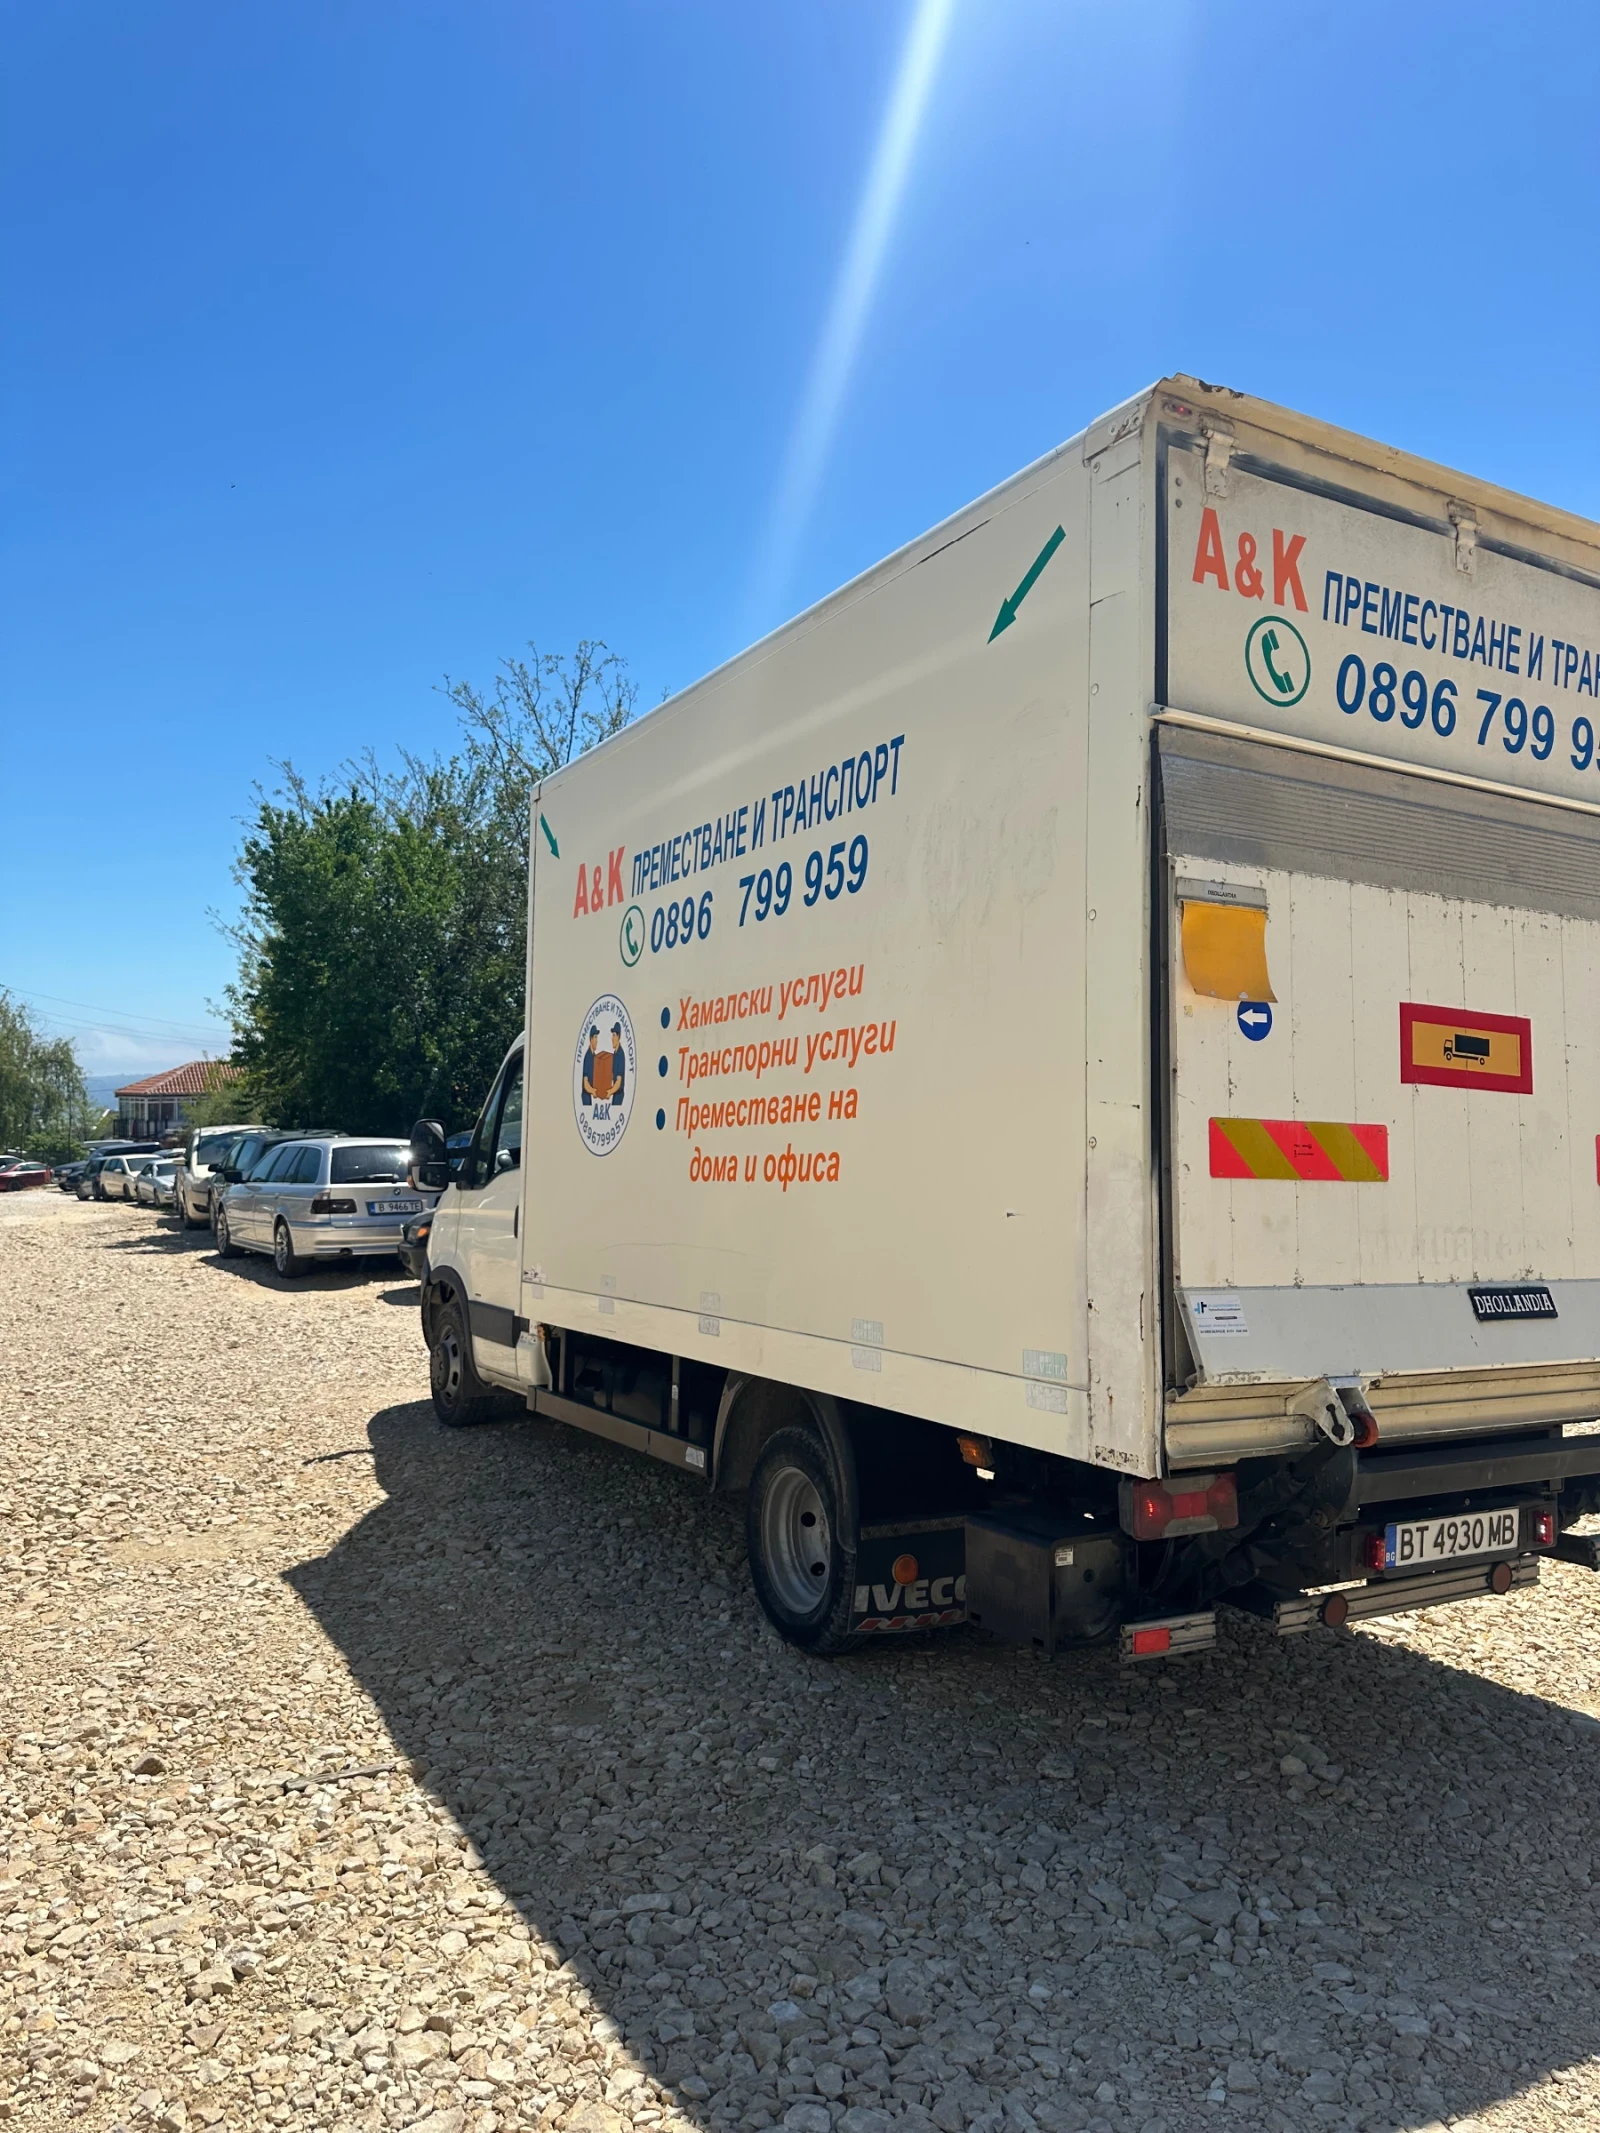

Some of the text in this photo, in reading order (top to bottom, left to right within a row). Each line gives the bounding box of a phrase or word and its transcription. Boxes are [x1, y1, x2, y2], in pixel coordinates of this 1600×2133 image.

[1323, 570, 1522, 674] ПРЕМЕСТВАНЕ
[1527, 632, 1544, 681] И
[1336, 654, 1600, 773] 0896 799 9
[631, 805, 749, 898] ПРЕМЕСТВАНЕ
[752, 798, 766, 851] И
[771, 734, 905, 843] ТРАНСПОРТ
[651, 834, 869, 954] 0896 799 959
[677, 964, 865, 1031] Хамалски услуги
[576, 1001, 610, 1063] ПРЕМЕСТВАНЕ
[615, 1005, 634, 1074] ТРАНСПОРТ
[678, 1020, 897, 1089] Транспорни услуги
[579, 1112, 625, 1147] 0896799959
[675, 1088, 858, 1139] Преместване на
[689, 1143, 840, 1192] дома и офиса
[378, 1202, 420, 1212] B 9466 TE
[1474, 1293, 1553, 1314] DHOLLANDIA
[1385, 1551, 1396, 1562] BG
[1400, 1513, 1515, 1561] BT 4930 MB
